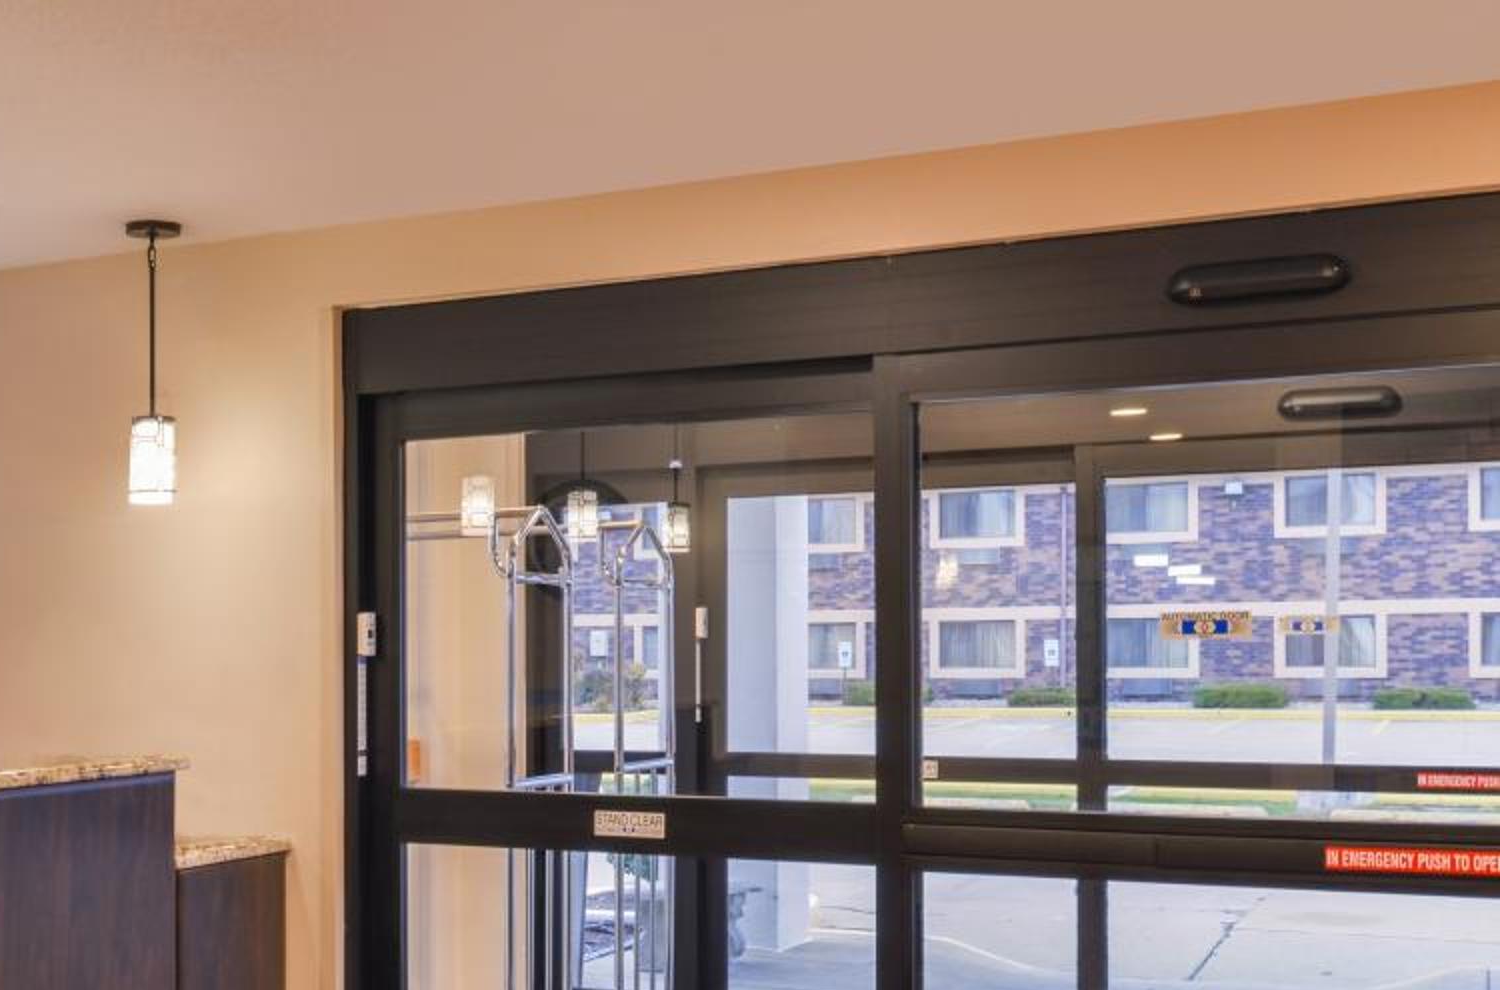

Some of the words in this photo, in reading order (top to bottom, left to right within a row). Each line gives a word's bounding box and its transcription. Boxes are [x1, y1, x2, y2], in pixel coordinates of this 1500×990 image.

[596, 812, 629, 825] STAND
[630, 814, 663, 828] CLEAR
[1327, 850, 1338, 866] IN
[1342, 851, 1414, 869] EMERGENCY
[1418, 853, 1451, 871] PUSH
[1455, 855, 1470, 872] TO
[1474, 855, 1500, 873] OPE
